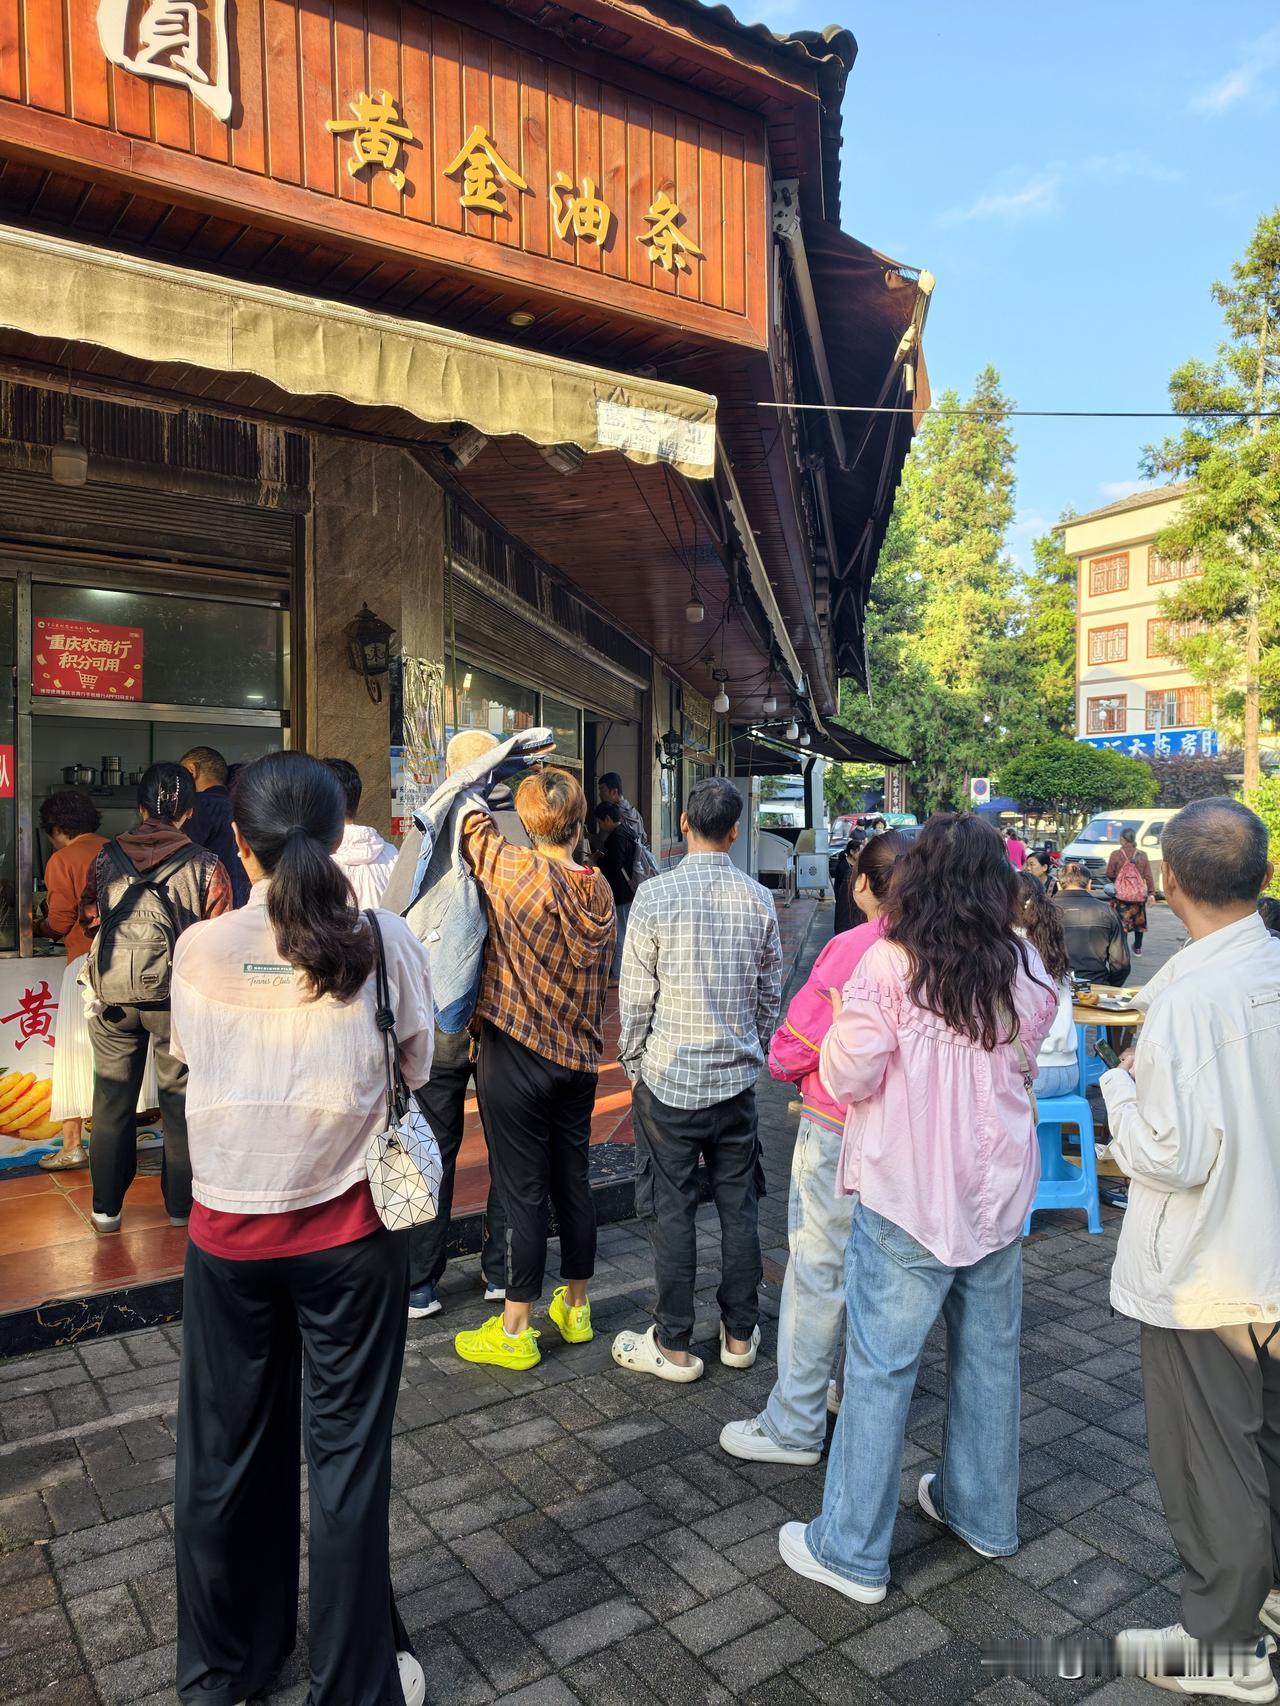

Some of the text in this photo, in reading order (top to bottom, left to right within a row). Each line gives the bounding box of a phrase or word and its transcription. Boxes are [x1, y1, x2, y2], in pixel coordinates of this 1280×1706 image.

[325, 88, 703, 272] 黄金油条
[45, 633, 133, 659] 重庆农商行
[58, 651, 120, 672] 积分可用
[0, 980, 59, 1051] 黄
